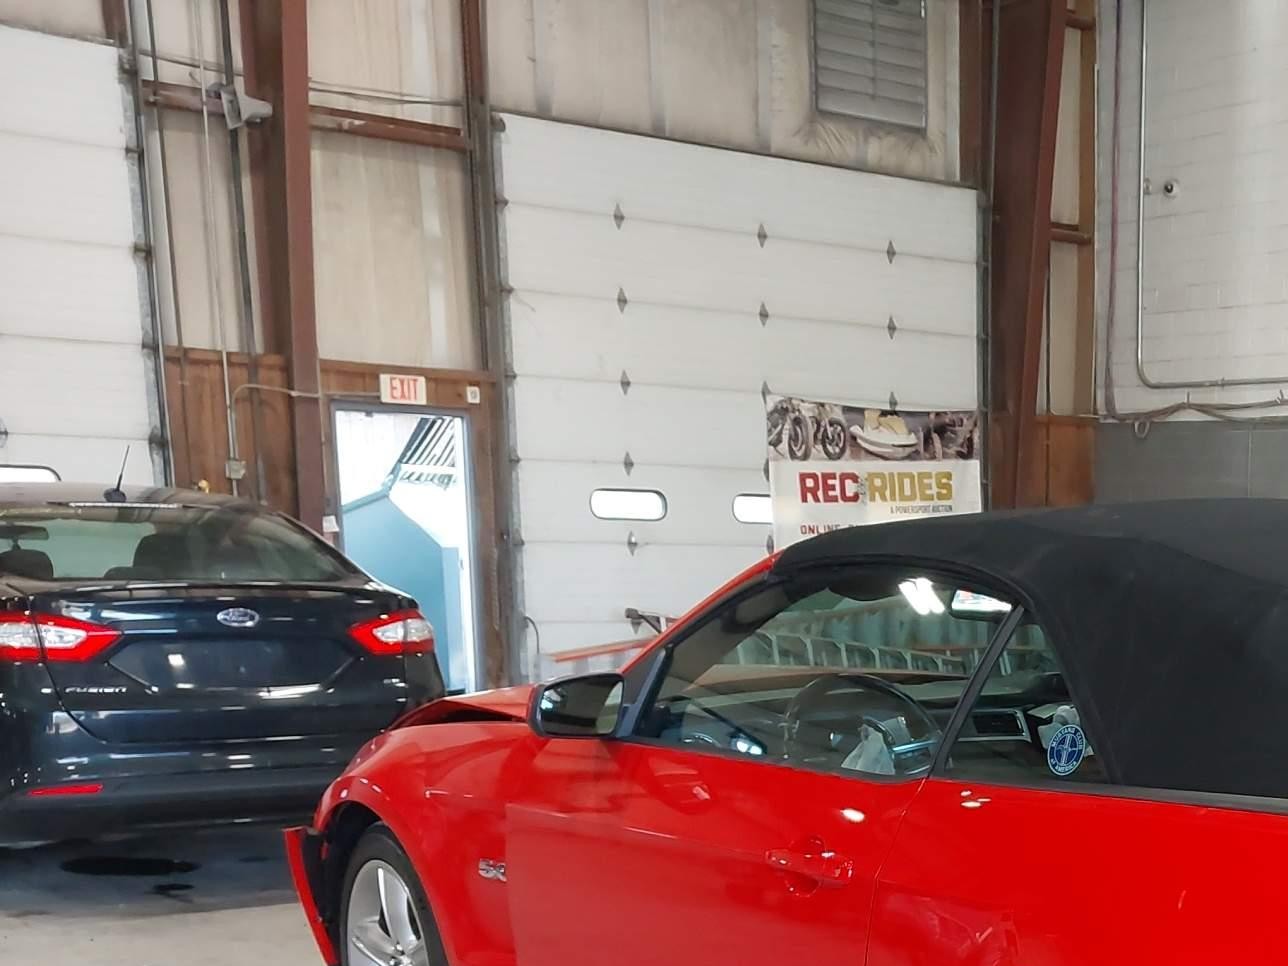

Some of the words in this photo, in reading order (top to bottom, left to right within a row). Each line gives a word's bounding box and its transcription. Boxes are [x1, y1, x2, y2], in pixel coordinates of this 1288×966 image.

[390, 376, 418, 400] EXIT
[799, 472, 860, 503] REC
[866, 471, 953, 503] RIDES
